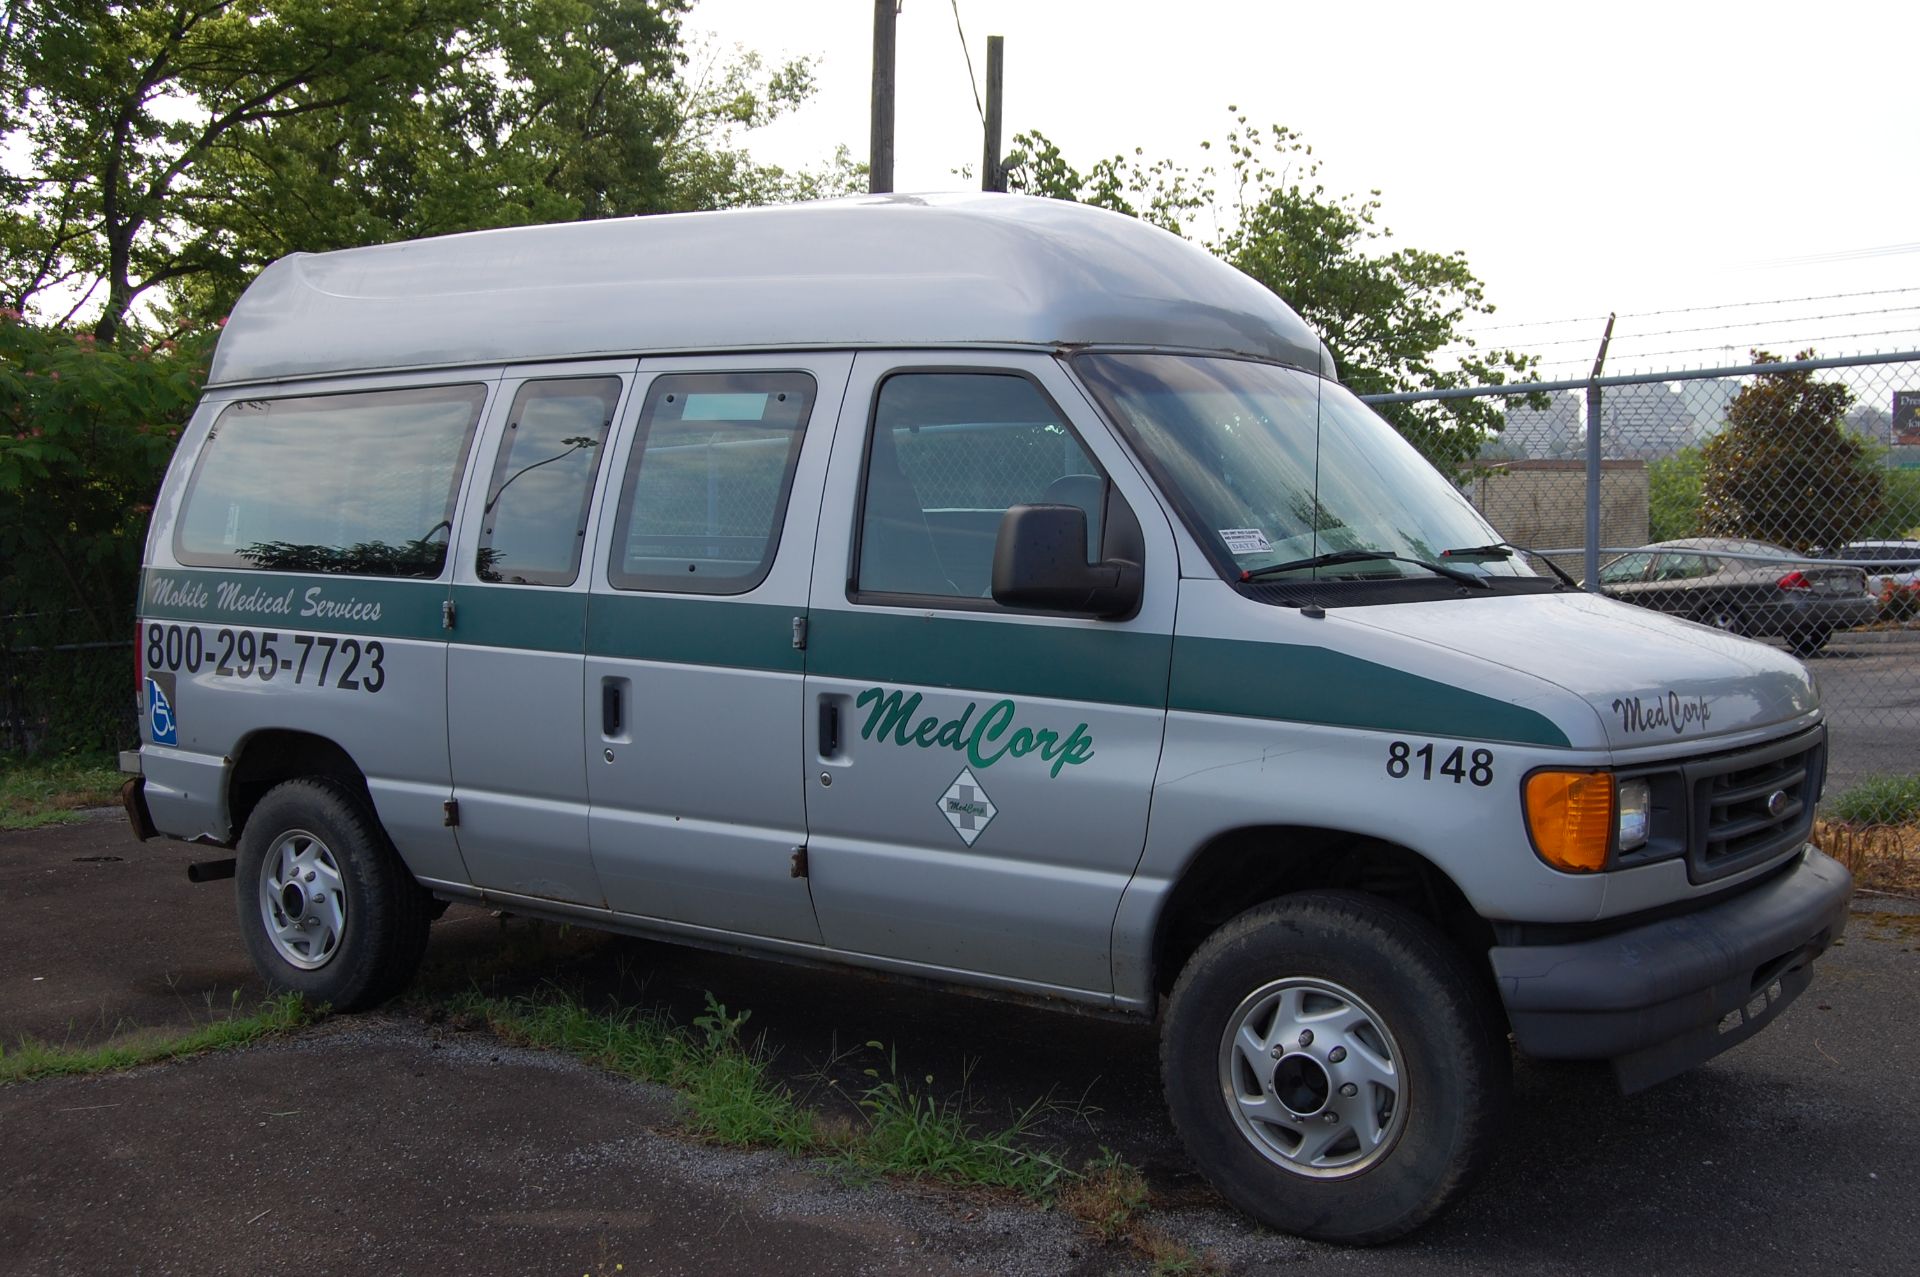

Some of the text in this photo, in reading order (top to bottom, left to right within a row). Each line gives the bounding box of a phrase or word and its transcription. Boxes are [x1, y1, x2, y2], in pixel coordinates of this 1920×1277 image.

[151, 578, 382, 621] Mobile Medical Services
[147, 623, 385, 693] 800-295-7723
[856, 687, 1095, 779] MedCorp
[1612, 690, 1711, 734] MedCorp
[1386, 741, 1494, 787] 8148
[949, 801, 985, 815] MedCorp
